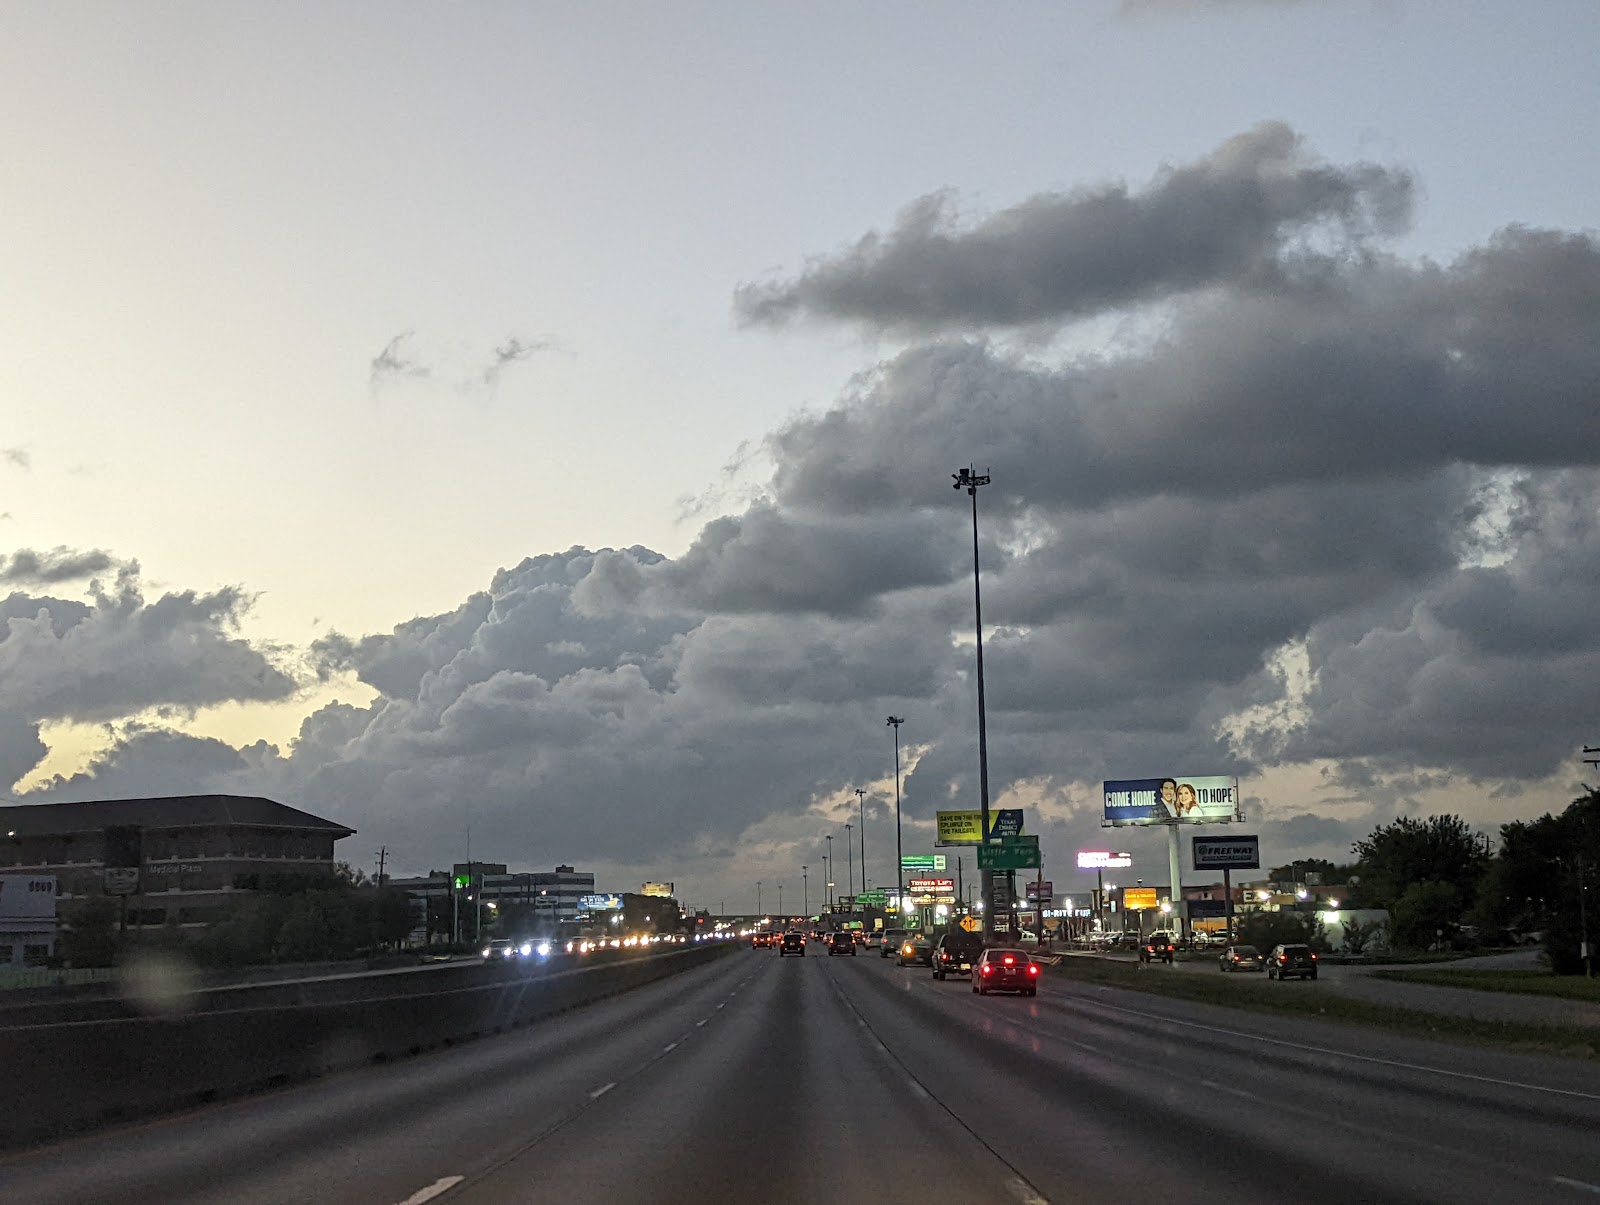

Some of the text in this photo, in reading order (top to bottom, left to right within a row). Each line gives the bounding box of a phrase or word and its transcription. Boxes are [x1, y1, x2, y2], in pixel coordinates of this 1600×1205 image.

[1105, 787, 1233, 807] COME HOME TO HOPE
[981, 847, 1034, 856] Little York
[1208, 847, 1253, 855] FREEWAY
[150, 864, 202, 873] Medical Plaza
[1042, 909, 1073, 918] BI-RITE
